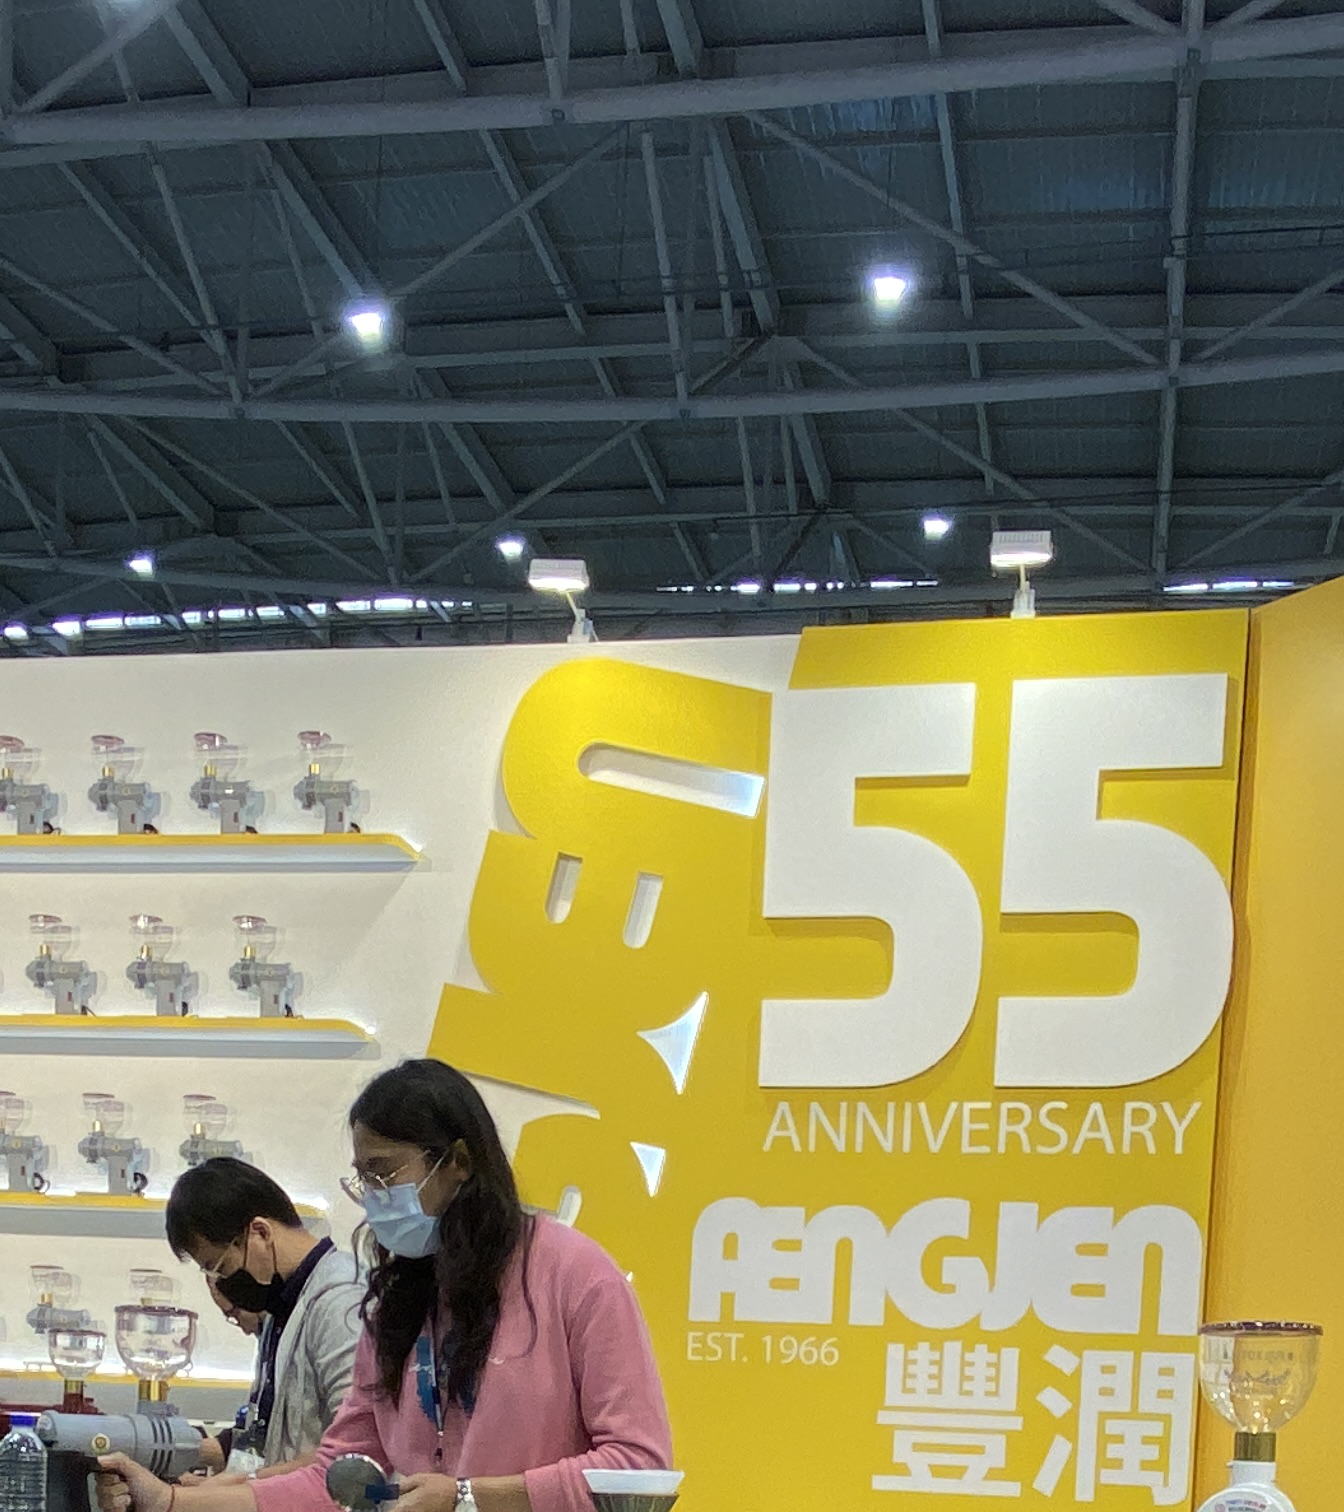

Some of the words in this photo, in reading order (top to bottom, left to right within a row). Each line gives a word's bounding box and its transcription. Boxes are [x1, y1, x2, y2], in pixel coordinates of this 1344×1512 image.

[758, 672, 1234, 1088] 55
[763, 1100, 1202, 1155] ANNIVERSARY
[687, 1331, 748, 1363] EST.
[761, 1334, 841, 1366] 1966
[871, 1340, 1196, 1507] 豐潤
